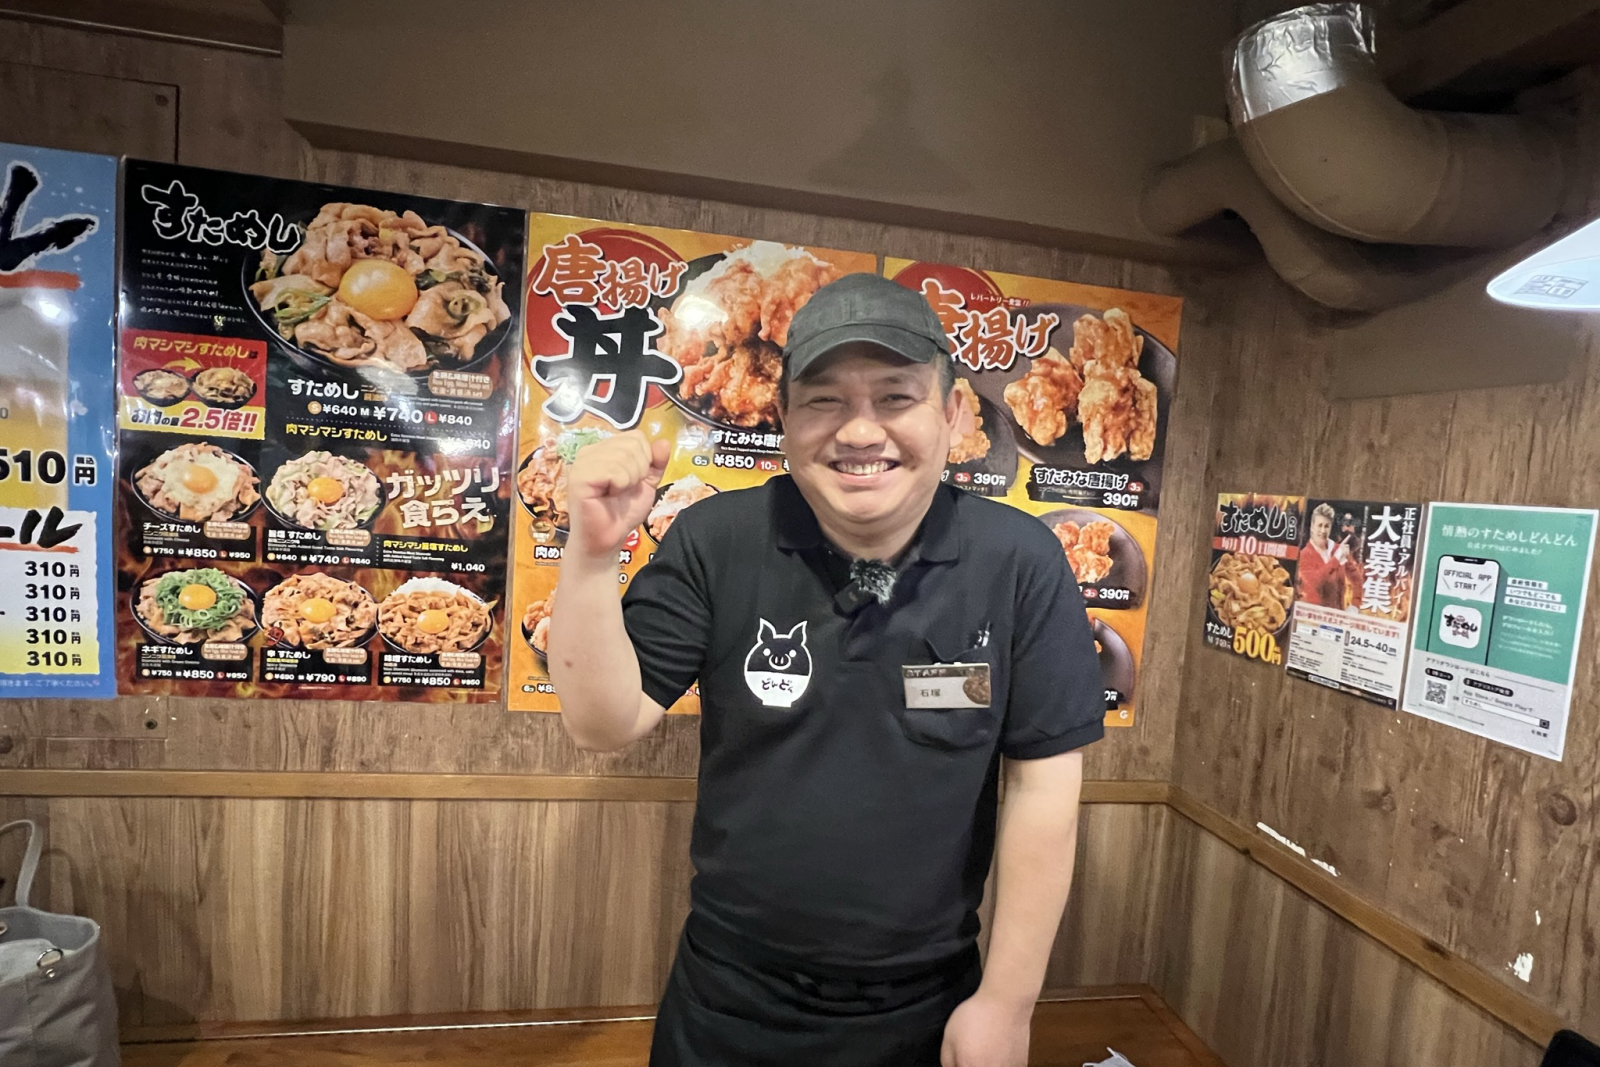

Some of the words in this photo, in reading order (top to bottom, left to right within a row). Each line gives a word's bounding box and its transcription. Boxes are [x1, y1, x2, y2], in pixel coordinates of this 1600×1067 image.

[141, 180, 301, 253] すためし
[533, 234, 688, 310] 唐揚げ
[134, 336, 249, 358] 肉マシマシすためし
[531, 305, 682, 429] 丼
[288, 378, 359, 399] すためし
[322, 404, 357, 416] ¥640
[360, 408, 370, 417] M
[373, 406, 423, 424] ¥740
[439, 413, 472, 425] ¥840
[286, 423, 387, 442] 肉マシマシすためし
[714, 453, 755, 468] ¥850
[386, 466, 500, 499] ガッツリ
[1034, 467, 1129, 490] すたみな唐揚げ
[400, 497, 492, 529] 食らえ
[143, 522, 201, 534] チーズすためし
[287, 531, 321, 540] すためし
[1442, 524, 1578, 547] 情熱のすためしどんどん
[186, 548, 217, 558] ¥850
[309, 554, 339, 564] ¥740
[1360, 505, 1402, 614] 大募集
[1392, 507, 1417, 619] 正社員・アルバイト
[1206, 622, 1233, 638] すためし
[141, 646, 193, 655] ネギすためし
[277, 650, 311, 659] すためし
[183, 670, 214, 679] ¥850
[306, 673, 336, 682] ¥790
[421, 677, 451, 686] ¥850
[906, 668, 947, 677] STAFF
